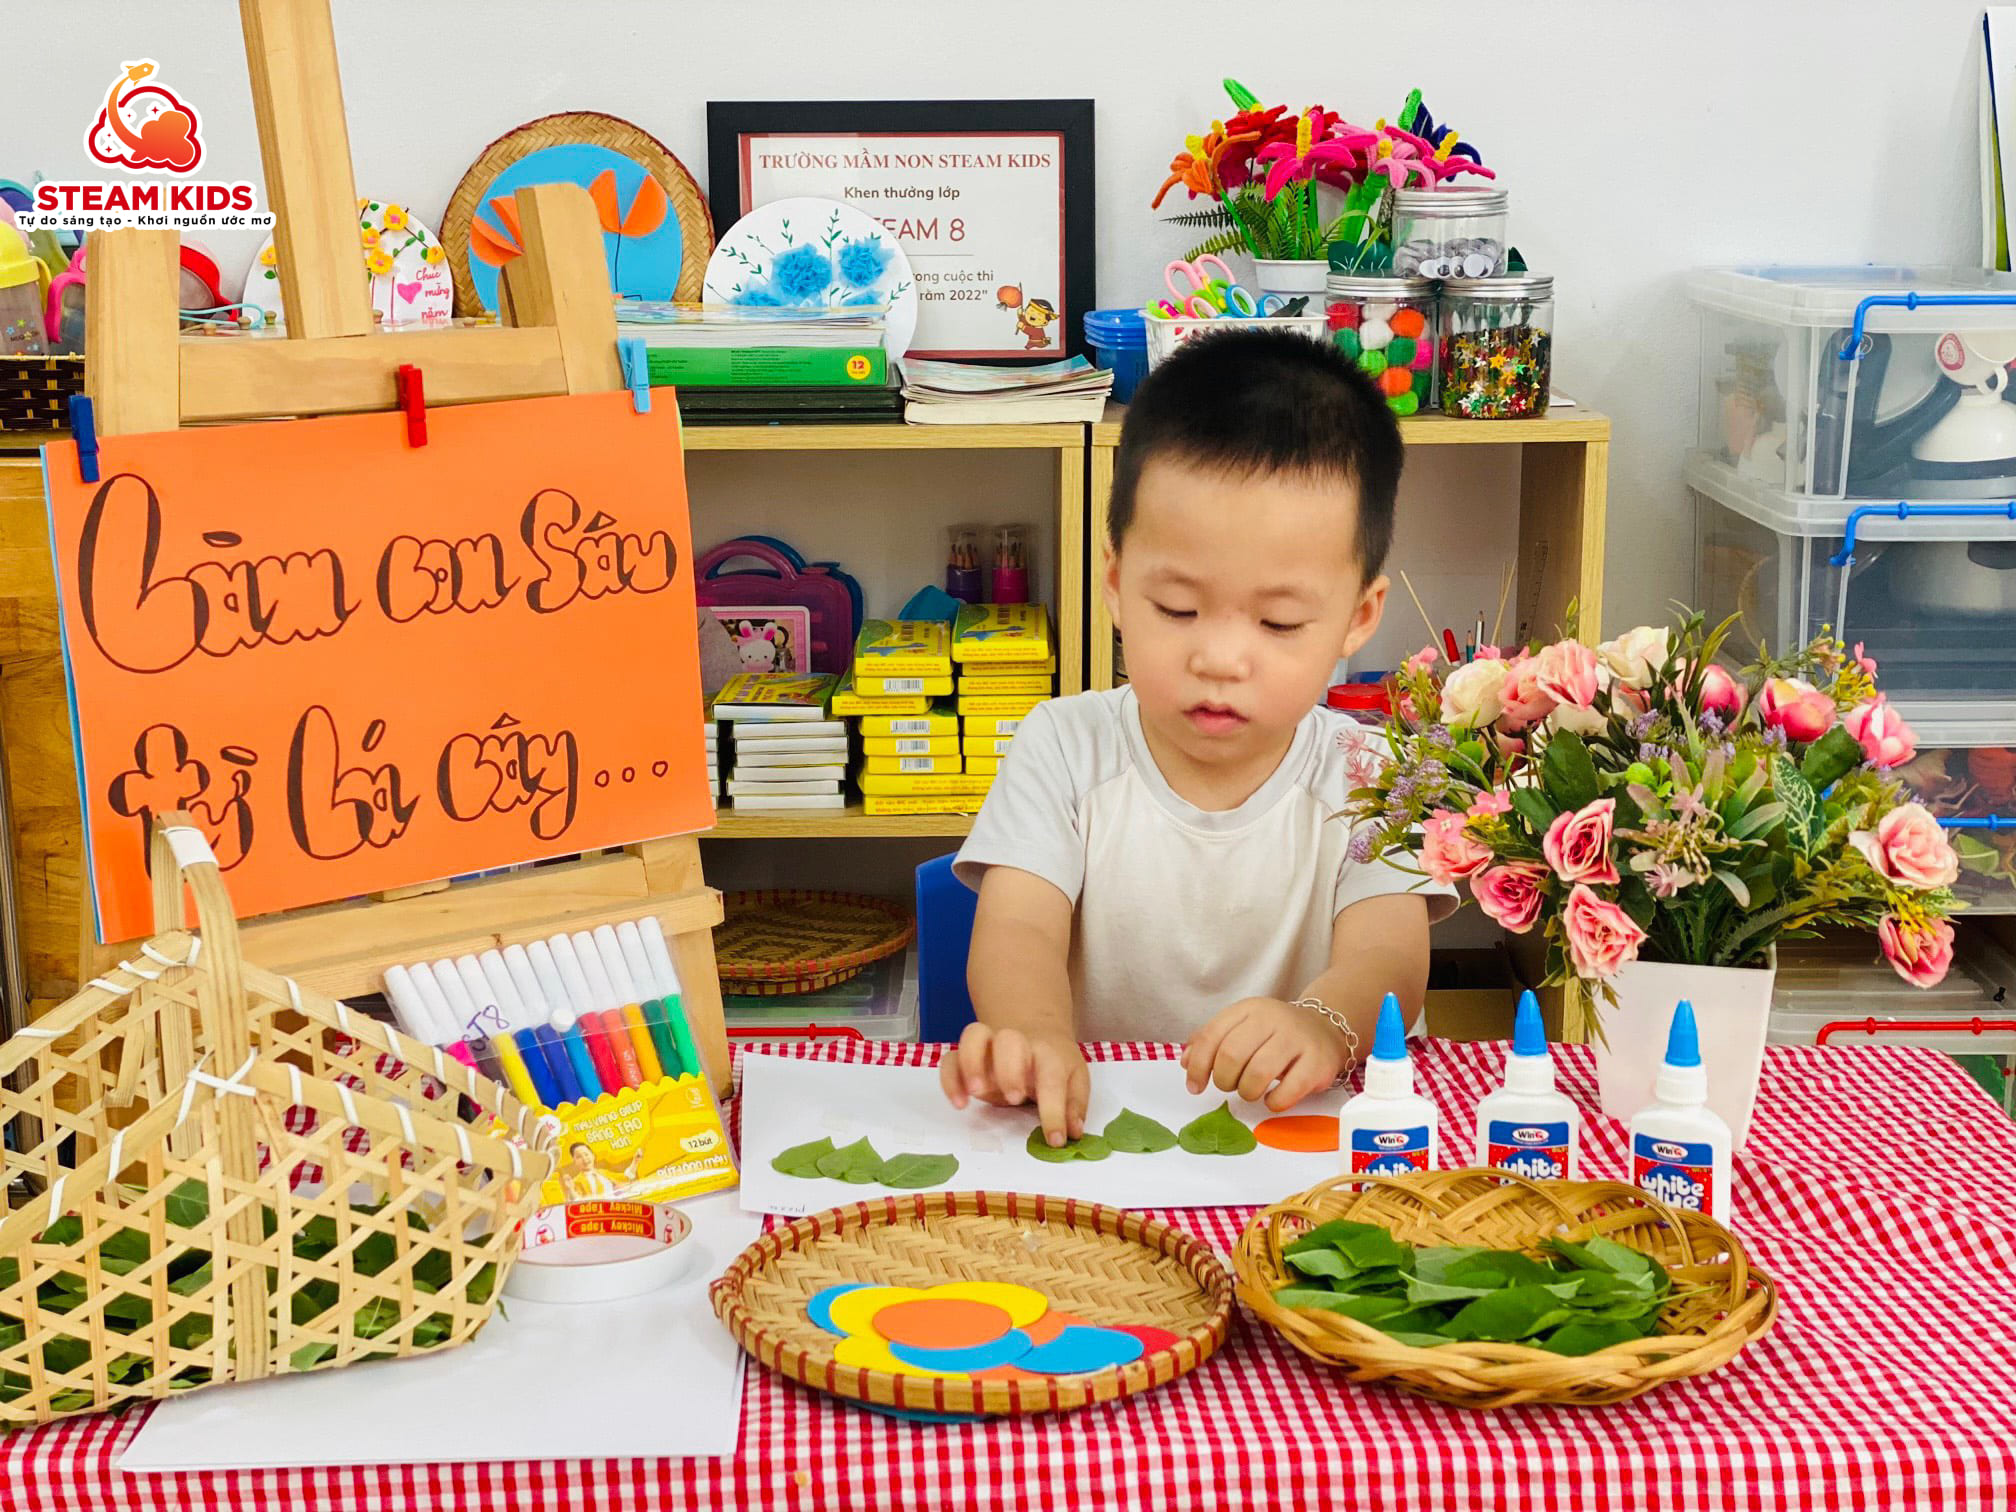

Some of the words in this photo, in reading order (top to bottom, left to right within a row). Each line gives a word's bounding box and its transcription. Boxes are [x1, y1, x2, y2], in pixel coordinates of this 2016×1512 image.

[759, 151, 838, 169] TRƯỜNG
[843, 147, 890, 169] MẦM
[895, 154, 934, 168] NON
[938, 154, 1002, 168] STEAM
[1008, 154, 1051, 168] KIDS
[844, 187, 880, 199] Khen
[884, 186, 934, 201] thưởng
[939, 186, 960, 201] lớp
[873, 217, 938, 241] EAM
[949, 218, 965, 242] 8
[943, 270, 974, 284] cuộc
[977, 270, 994, 281] thi
[949, 289, 988, 301] 2022"
[852, 360, 865, 370] 12
[78, 472, 362, 674] Làm
[376, 532, 522, 623] con
[520, 488, 677, 614] Sâu
[688, 1139, 698, 1149] 12
[699, 1137, 713, 1147] bút
[1640, 1173, 1705, 1198] white
[580, 1221, 606, 1233] Tape
[611, 1220, 645, 1233] Mickey
